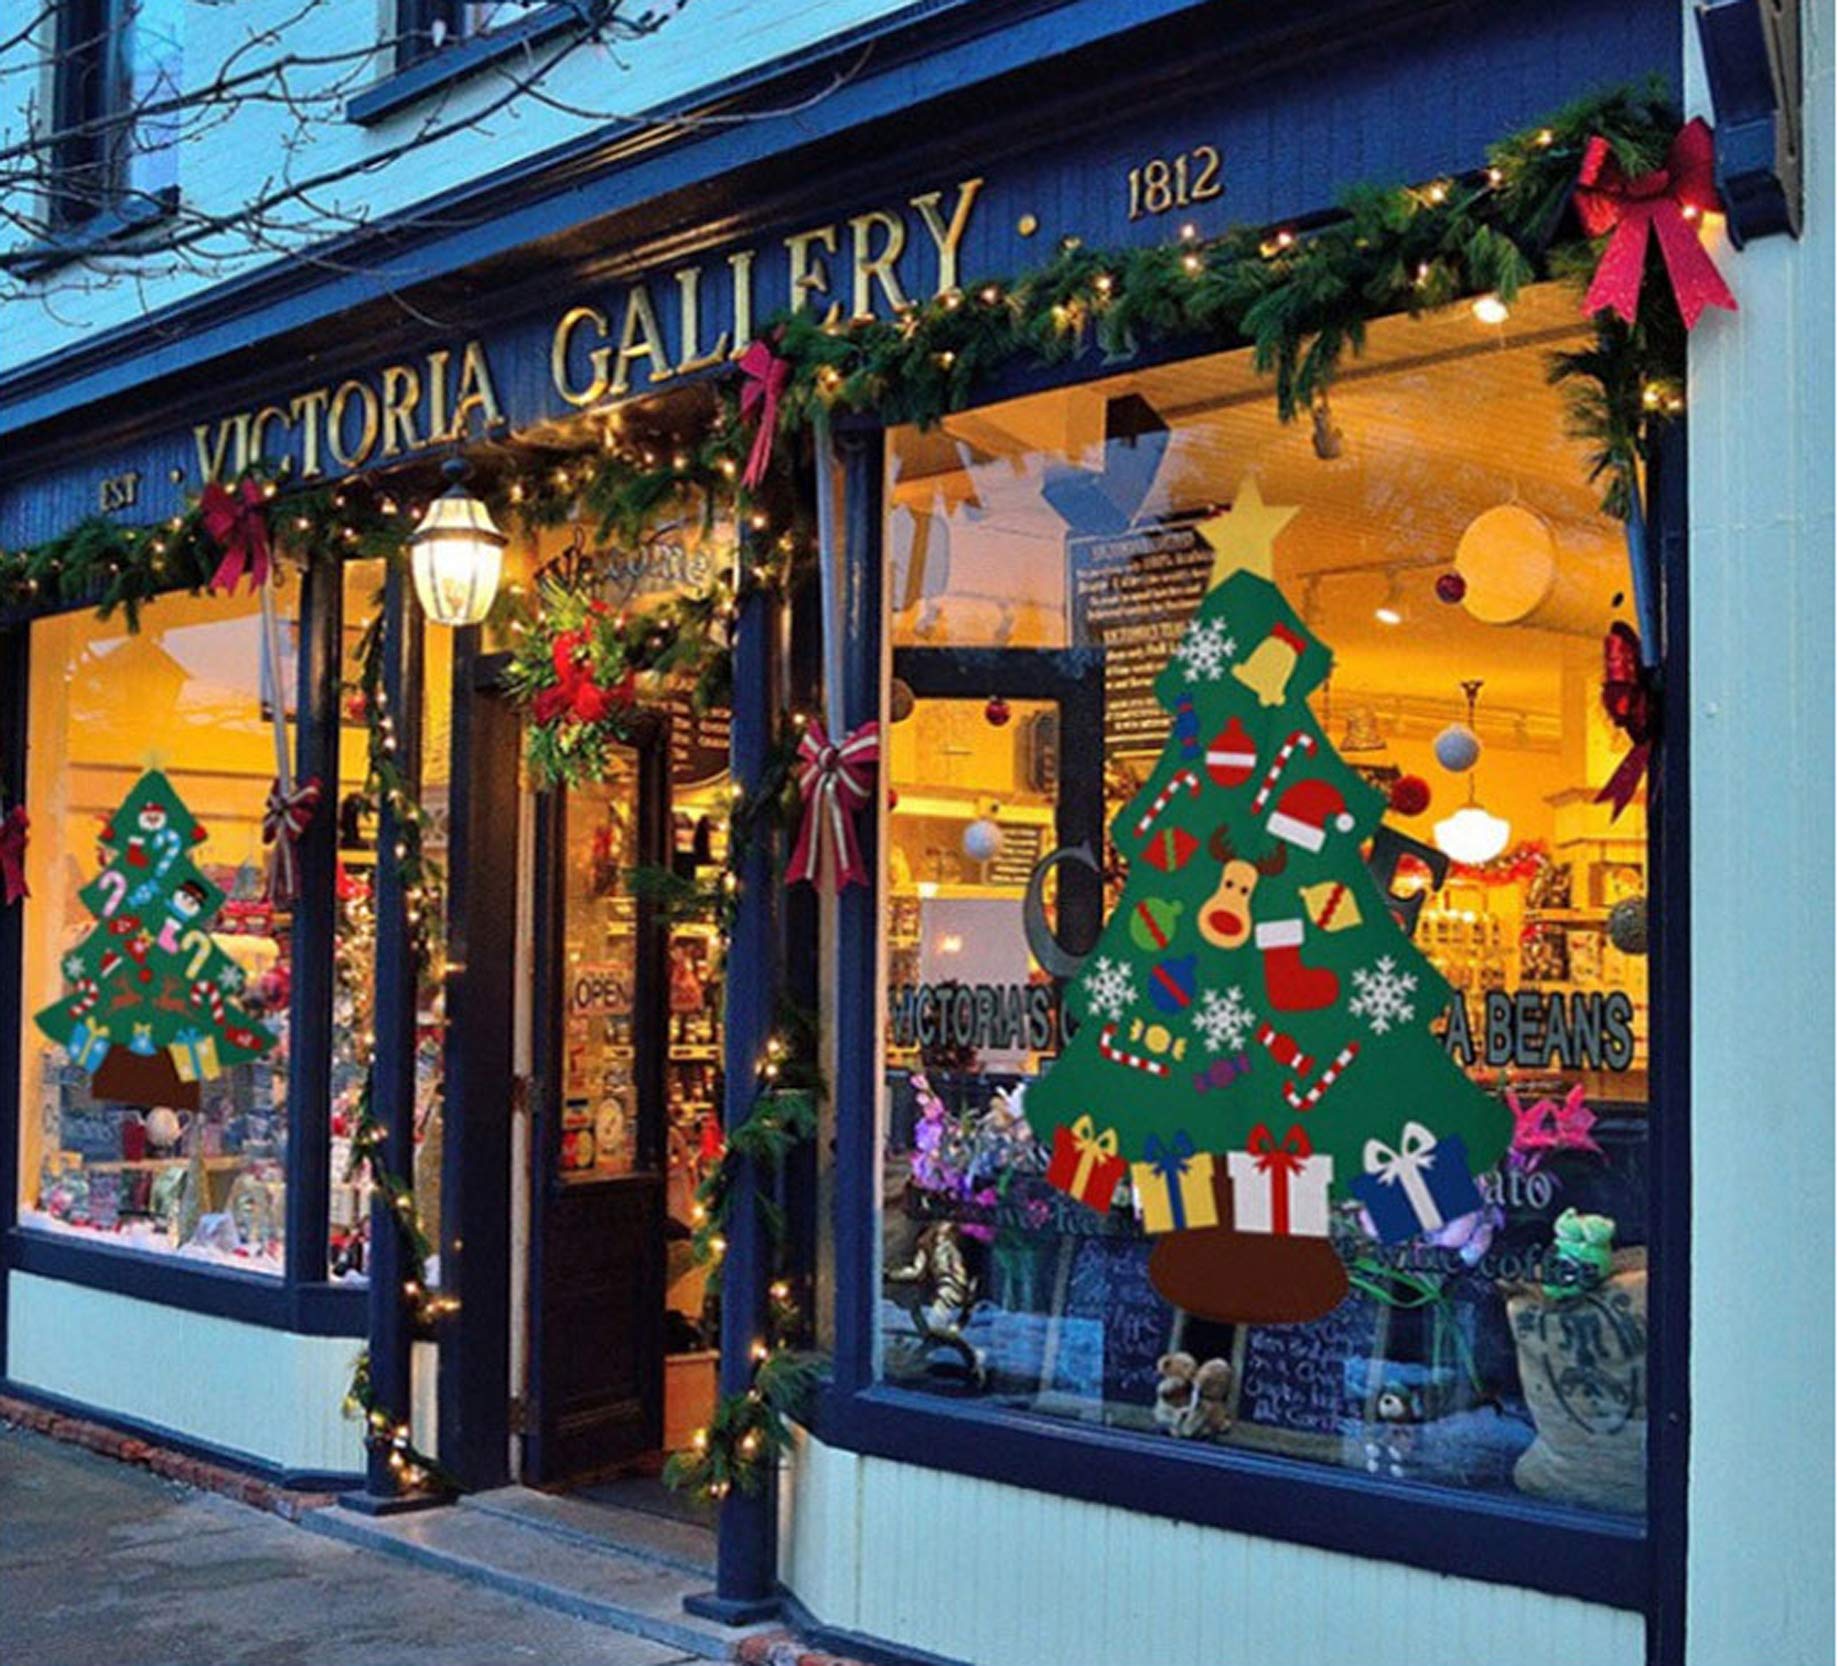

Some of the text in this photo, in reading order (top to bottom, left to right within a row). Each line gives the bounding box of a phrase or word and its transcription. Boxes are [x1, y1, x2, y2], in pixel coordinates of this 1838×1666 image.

[103, 471, 139, 513] EST
[193, 340, 506, 484] VICTORIA
[551, 177, 984, 407] GALLERY
[1127, 145, 1222, 220] 1812
[574, 976, 630, 1009] OPEN
[1485, 988, 1635, 1072] BEANS
